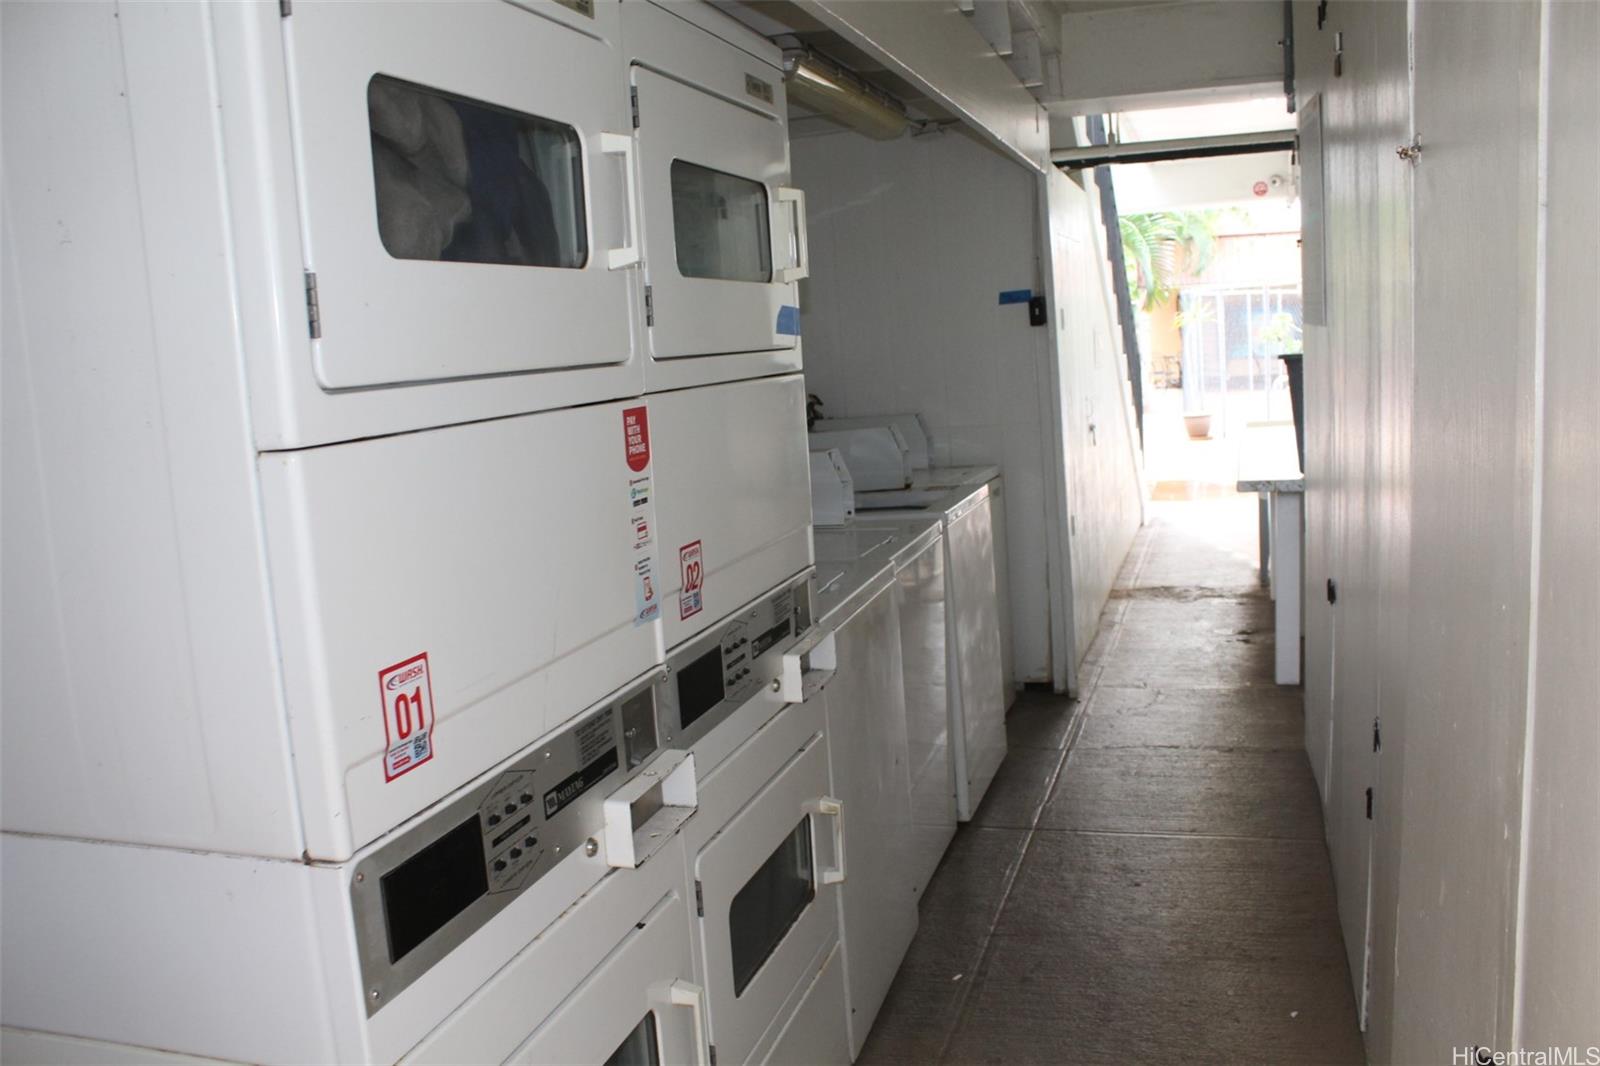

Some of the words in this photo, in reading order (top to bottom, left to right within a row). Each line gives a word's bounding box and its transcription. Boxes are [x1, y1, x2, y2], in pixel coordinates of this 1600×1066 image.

[629, 443, 646, 455] PHONE
[685, 561, 699, 593] 02
[395, 686, 424, 740] 01
